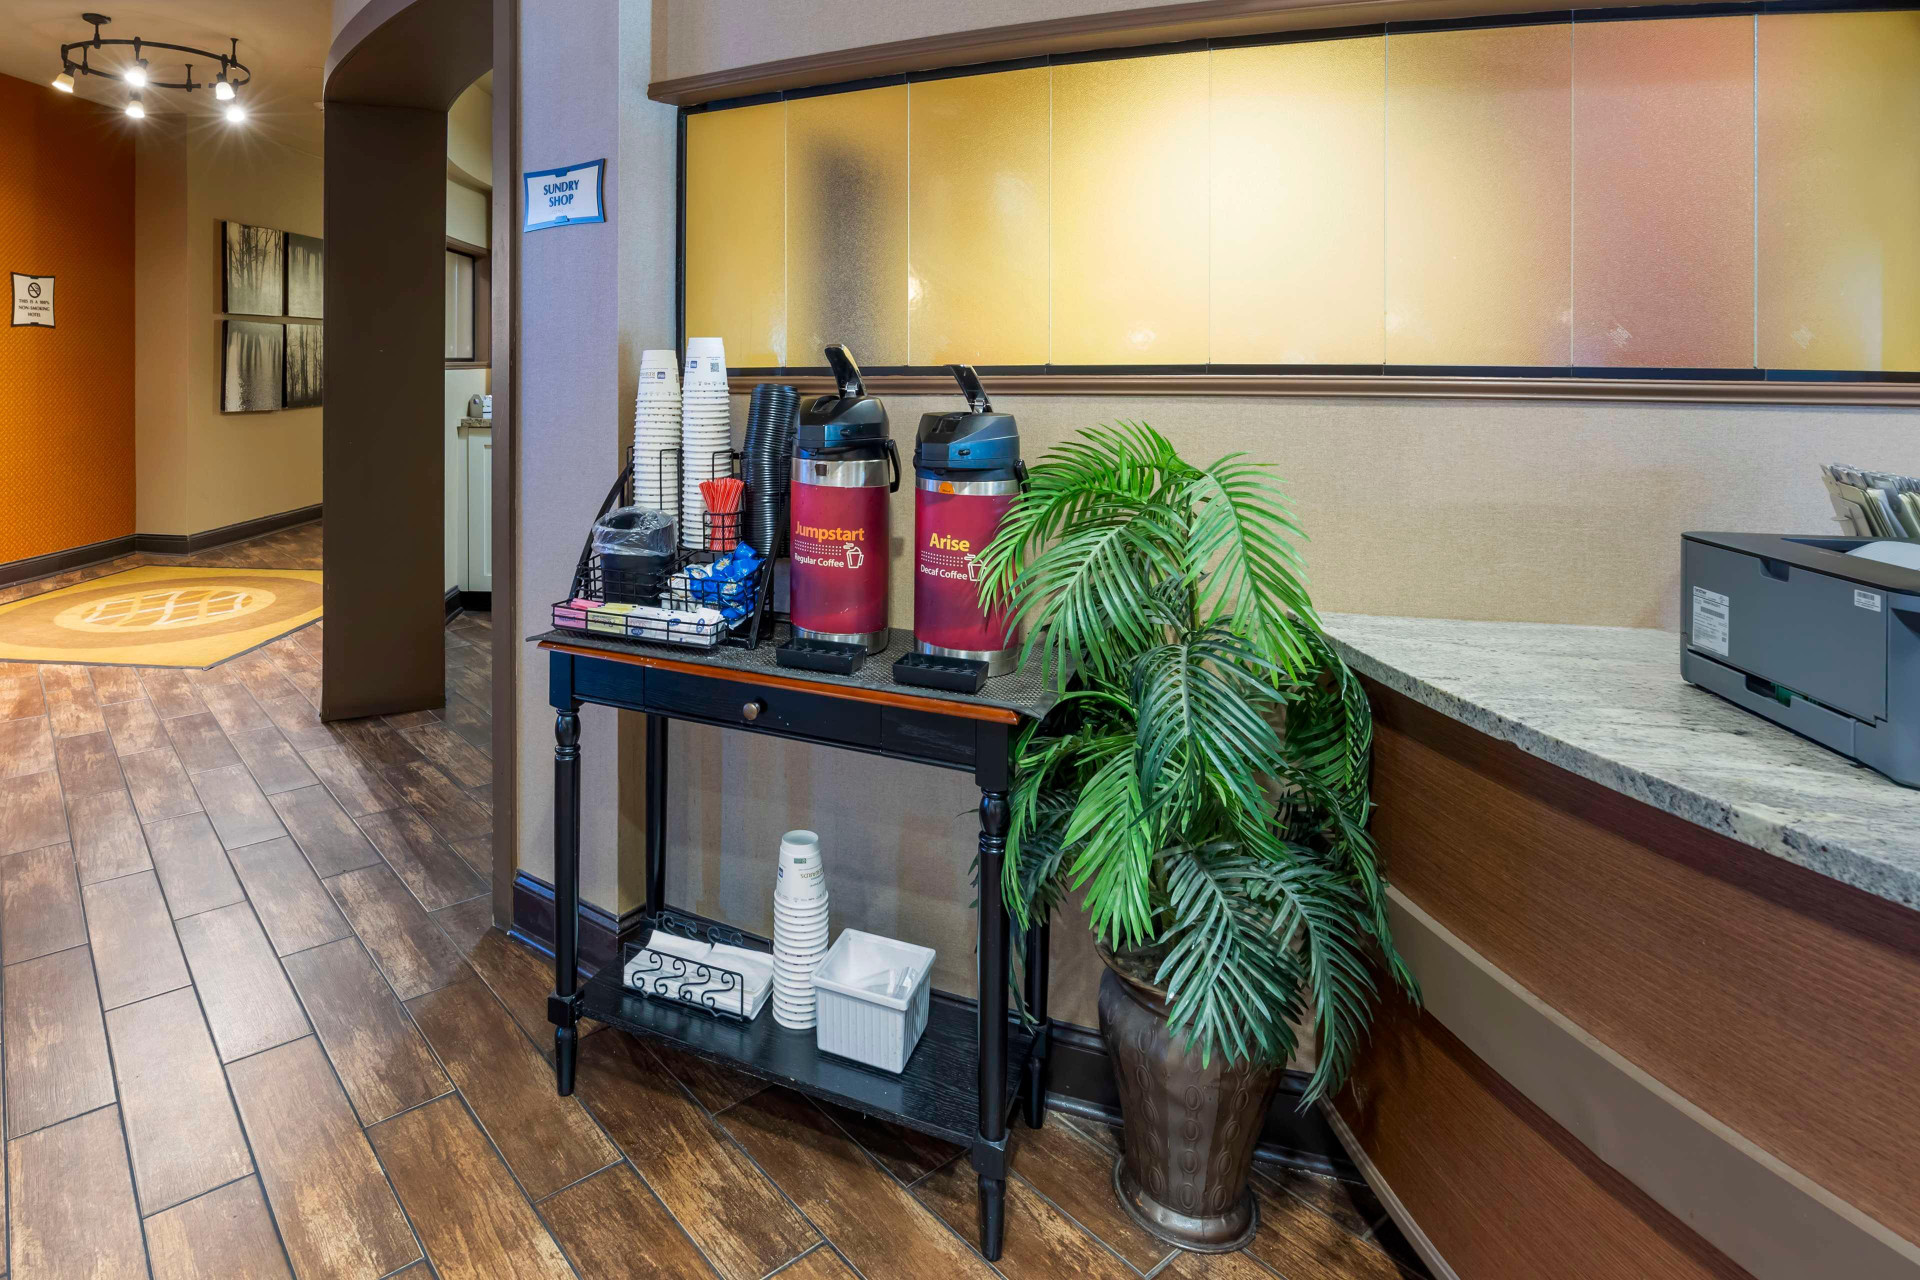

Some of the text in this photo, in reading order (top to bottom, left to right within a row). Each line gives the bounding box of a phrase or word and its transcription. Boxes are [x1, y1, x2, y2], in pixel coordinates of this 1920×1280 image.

[543, 180, 580, 195] SUNDRY
[549, 193, 574, 207] SHOP
[795, 520, 865, 543] Jumpstart
[929, 532, 970, 552] Arise
[794, 552, 845, 568] Regular Coffee
[920, 564, 968, 580] Decaf Coffee
